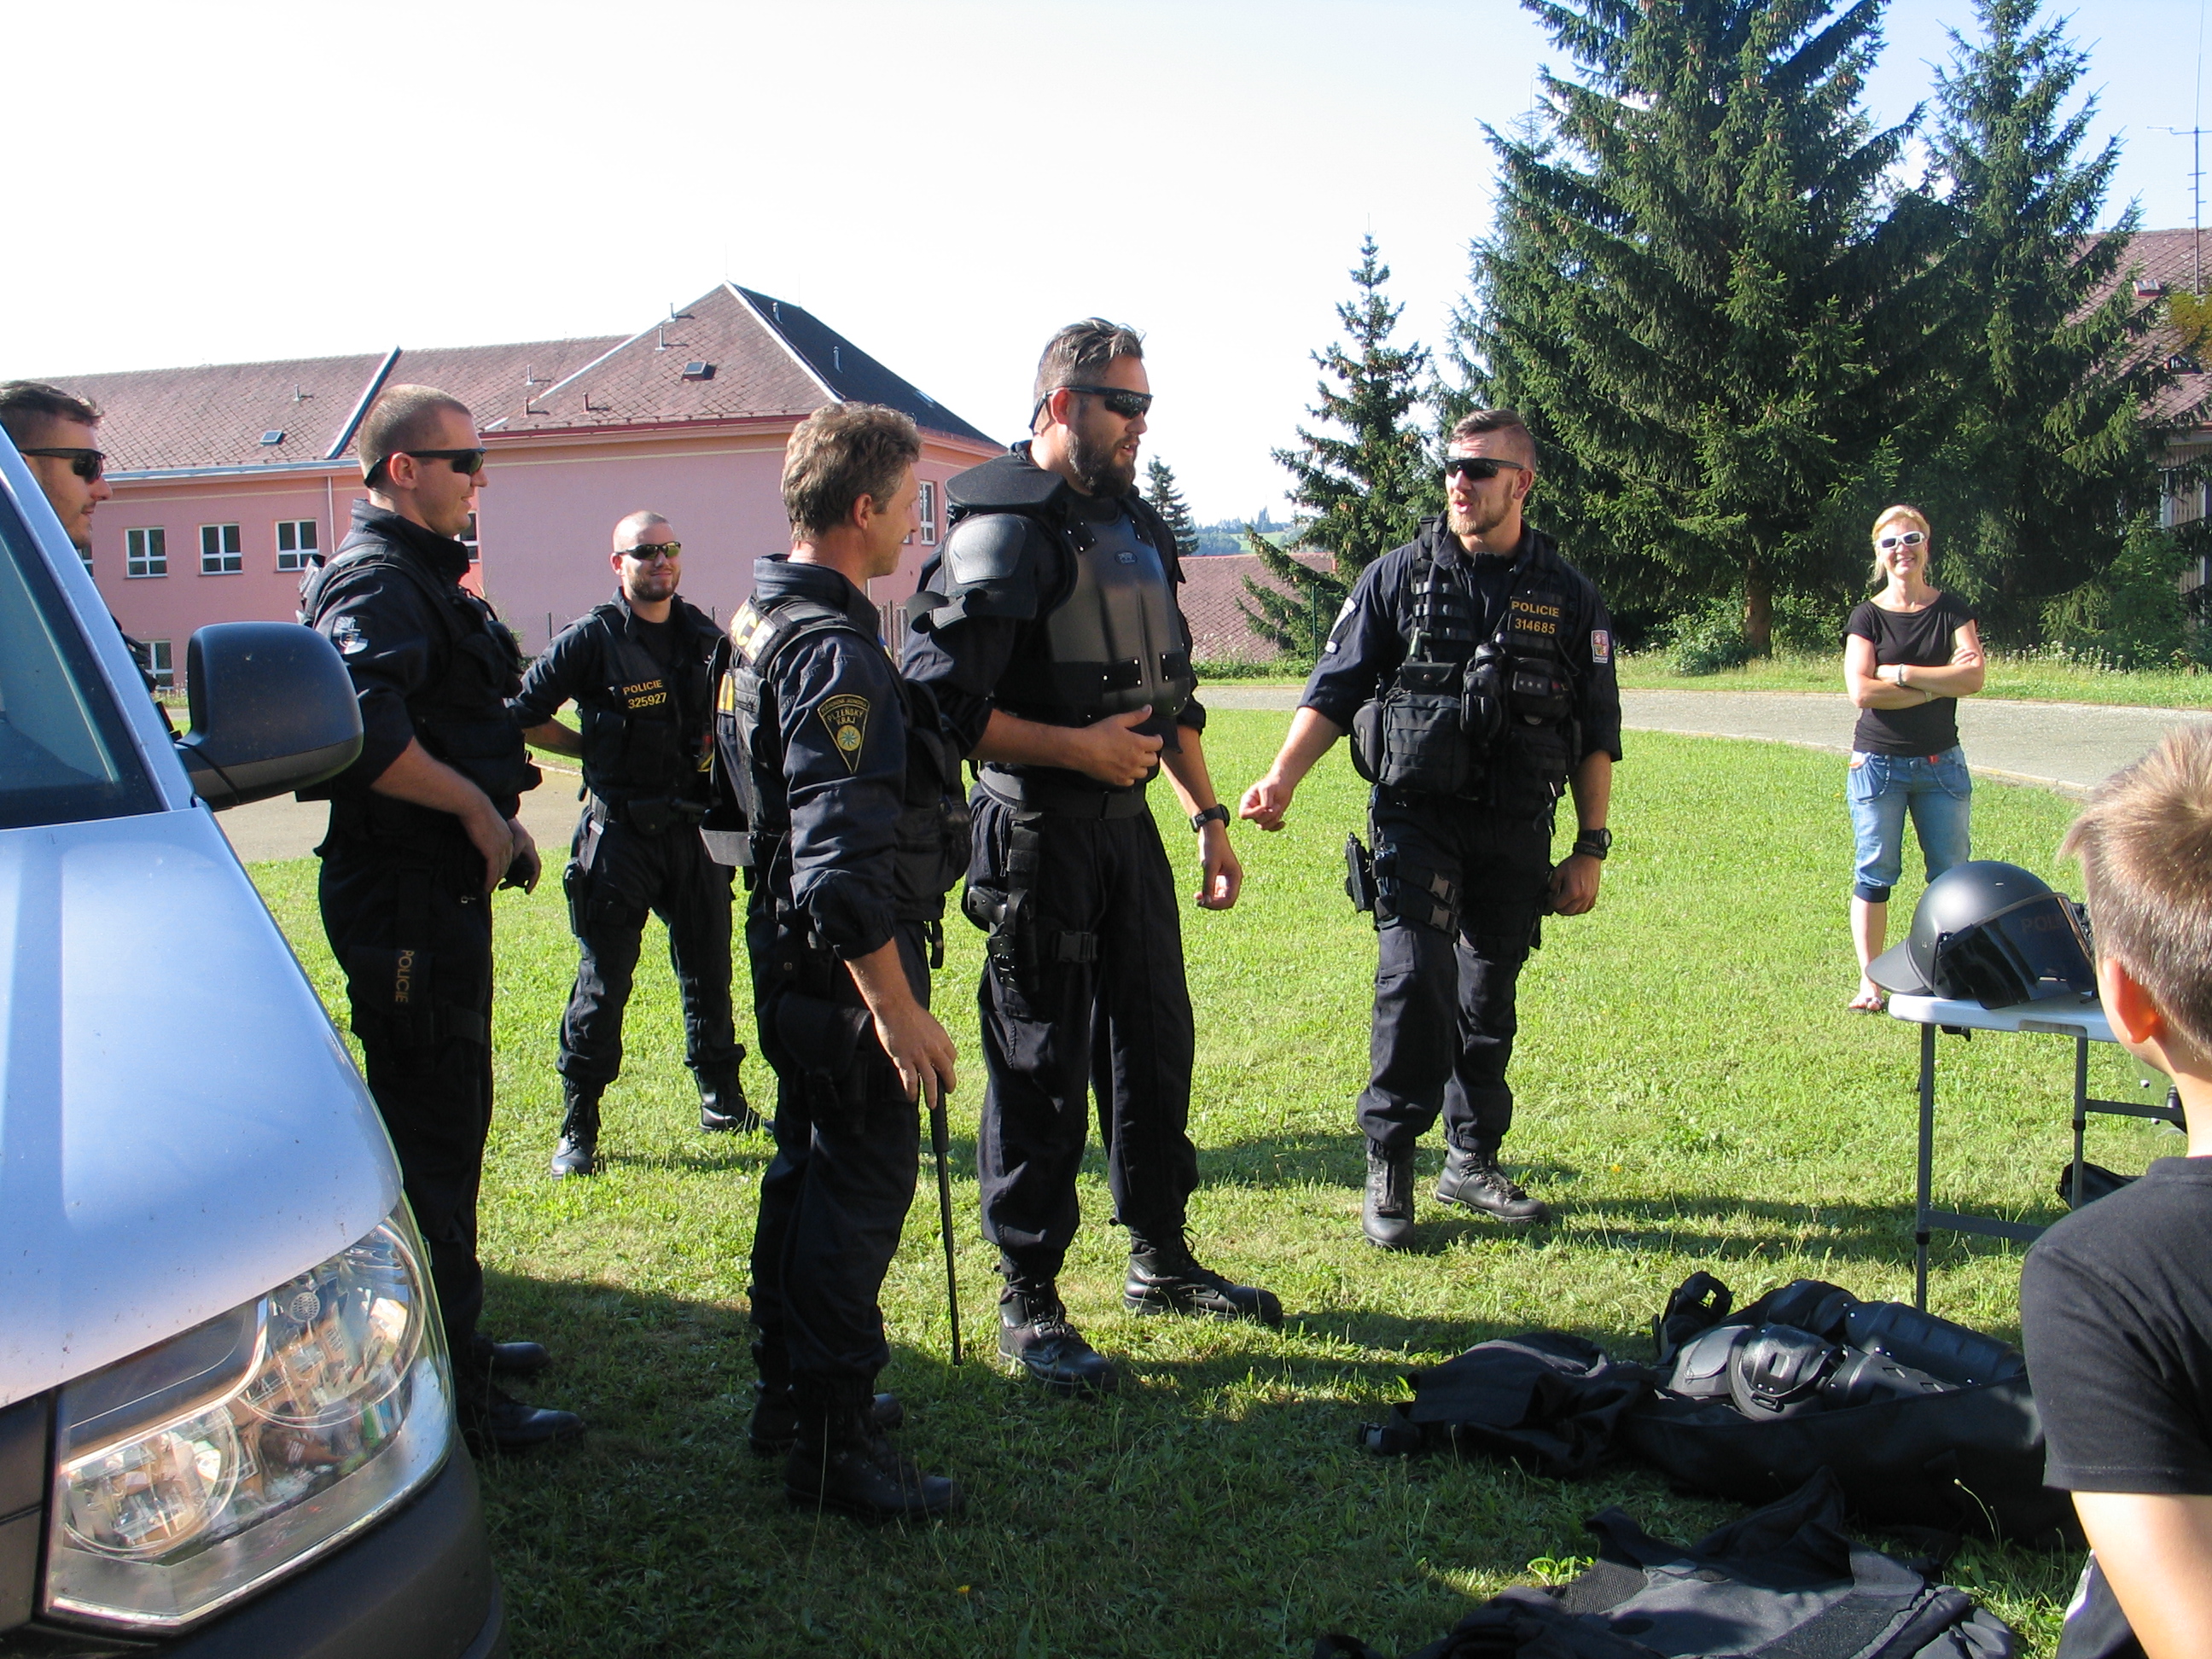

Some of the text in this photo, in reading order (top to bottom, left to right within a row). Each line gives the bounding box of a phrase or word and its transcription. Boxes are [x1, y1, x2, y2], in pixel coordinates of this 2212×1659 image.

[1511, 600, 1560, 618] POLICIE
[1514, 618, 1556, 635] 314685
[622, 679, 663, 696] POLICIE
[627, 692, 667, 709] 325927
[396, 949, 416, 1003] POLICIE
